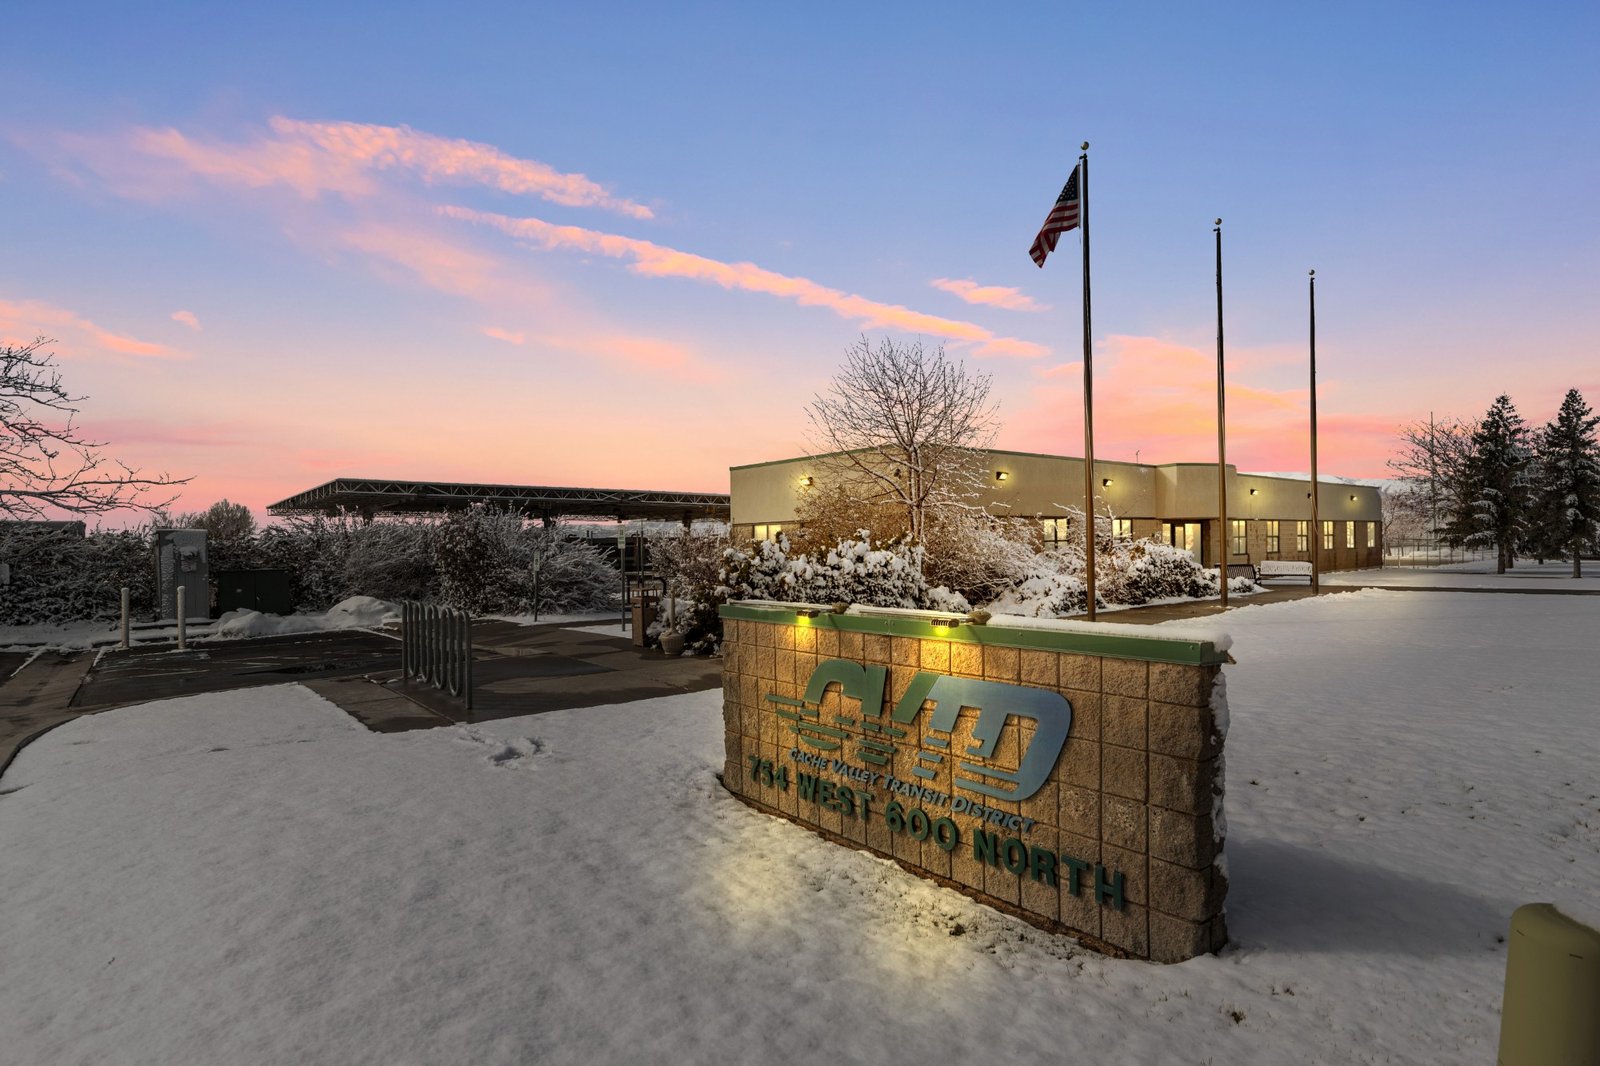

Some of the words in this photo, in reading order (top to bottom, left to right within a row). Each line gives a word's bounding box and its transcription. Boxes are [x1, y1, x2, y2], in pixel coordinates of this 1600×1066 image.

[748, 754, 788, 792] 754
[796, 771, 873, 822] WEST
[885, 800, 958, 850] 600
[972, 828, 1125, 911] NORTH
[788, 747, 828, 770] CACHE
[831, 758, 880, 785] VALLEY
[882, 774, 950, 807] TRANSIT
[950, 795, 1036, 833] DISTRICT
